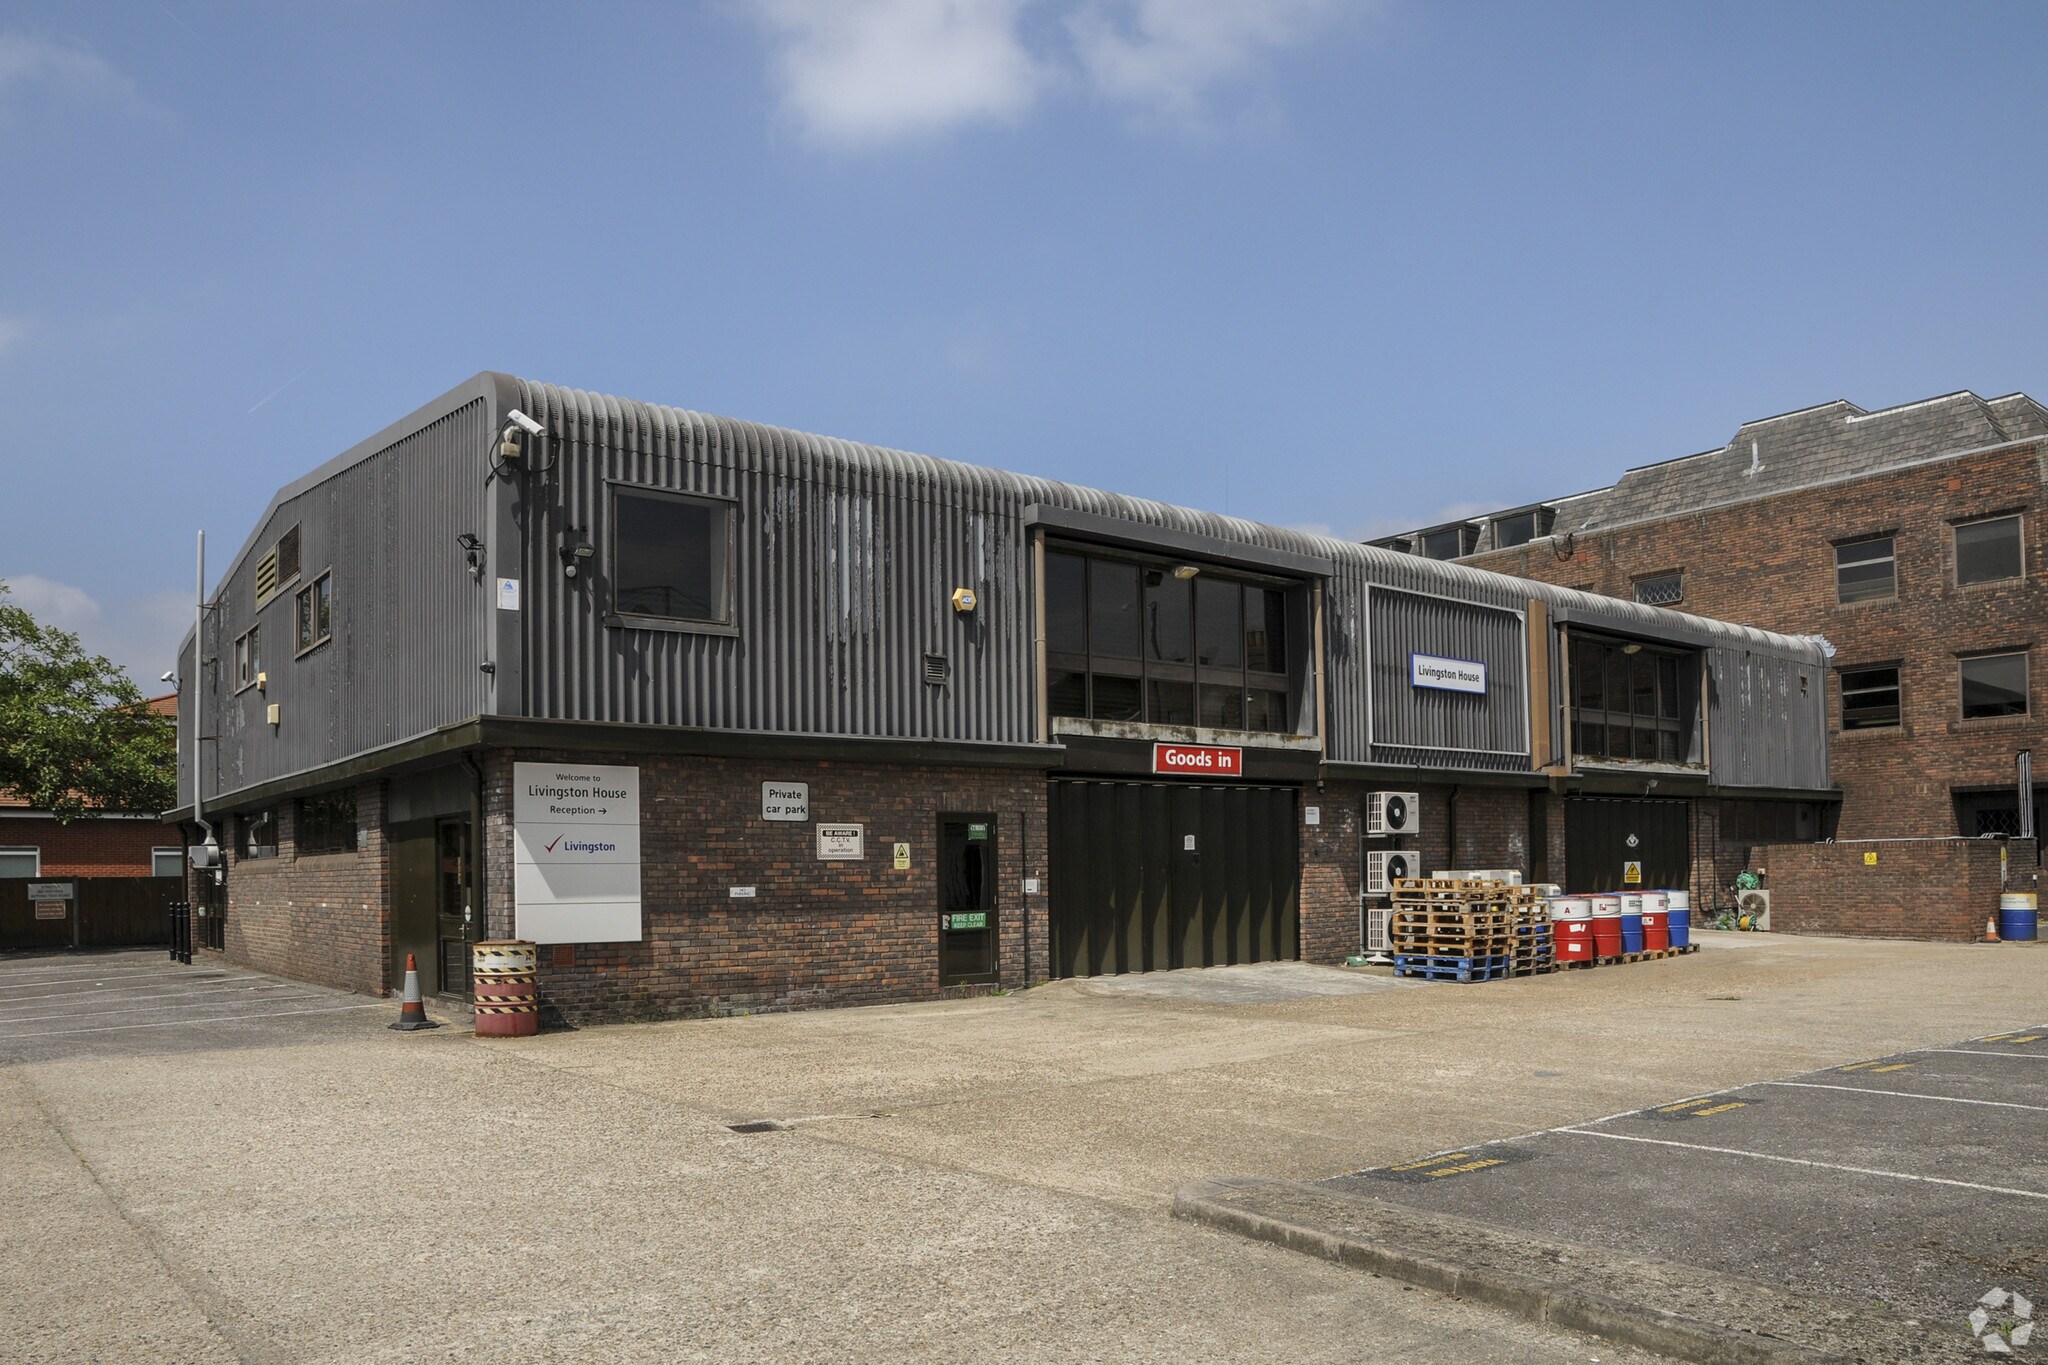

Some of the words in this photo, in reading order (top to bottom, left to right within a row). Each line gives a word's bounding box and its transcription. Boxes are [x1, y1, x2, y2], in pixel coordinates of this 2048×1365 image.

[1418, 664, 1457, 681] Livingston
[1458, 670, 1480, 682] House
[1165, 749, 1213, 767] Goods
[1218, 751, 1232, 768] in
[555, 773, 591, 782] Welcome
[528, 784, 589, 800] Livingston
[592, 787, 627, 799] House
[769, 789, 802, 800] Private
[550, 805, 595, 816] Reception
[766, 805, 781, 813] car
[785, 804, 806, 815] park
[564, 840, 616, 854] Livingston
[952, 914, 968, 922] FIRE
[969, 913, 986, 921] EXIT
